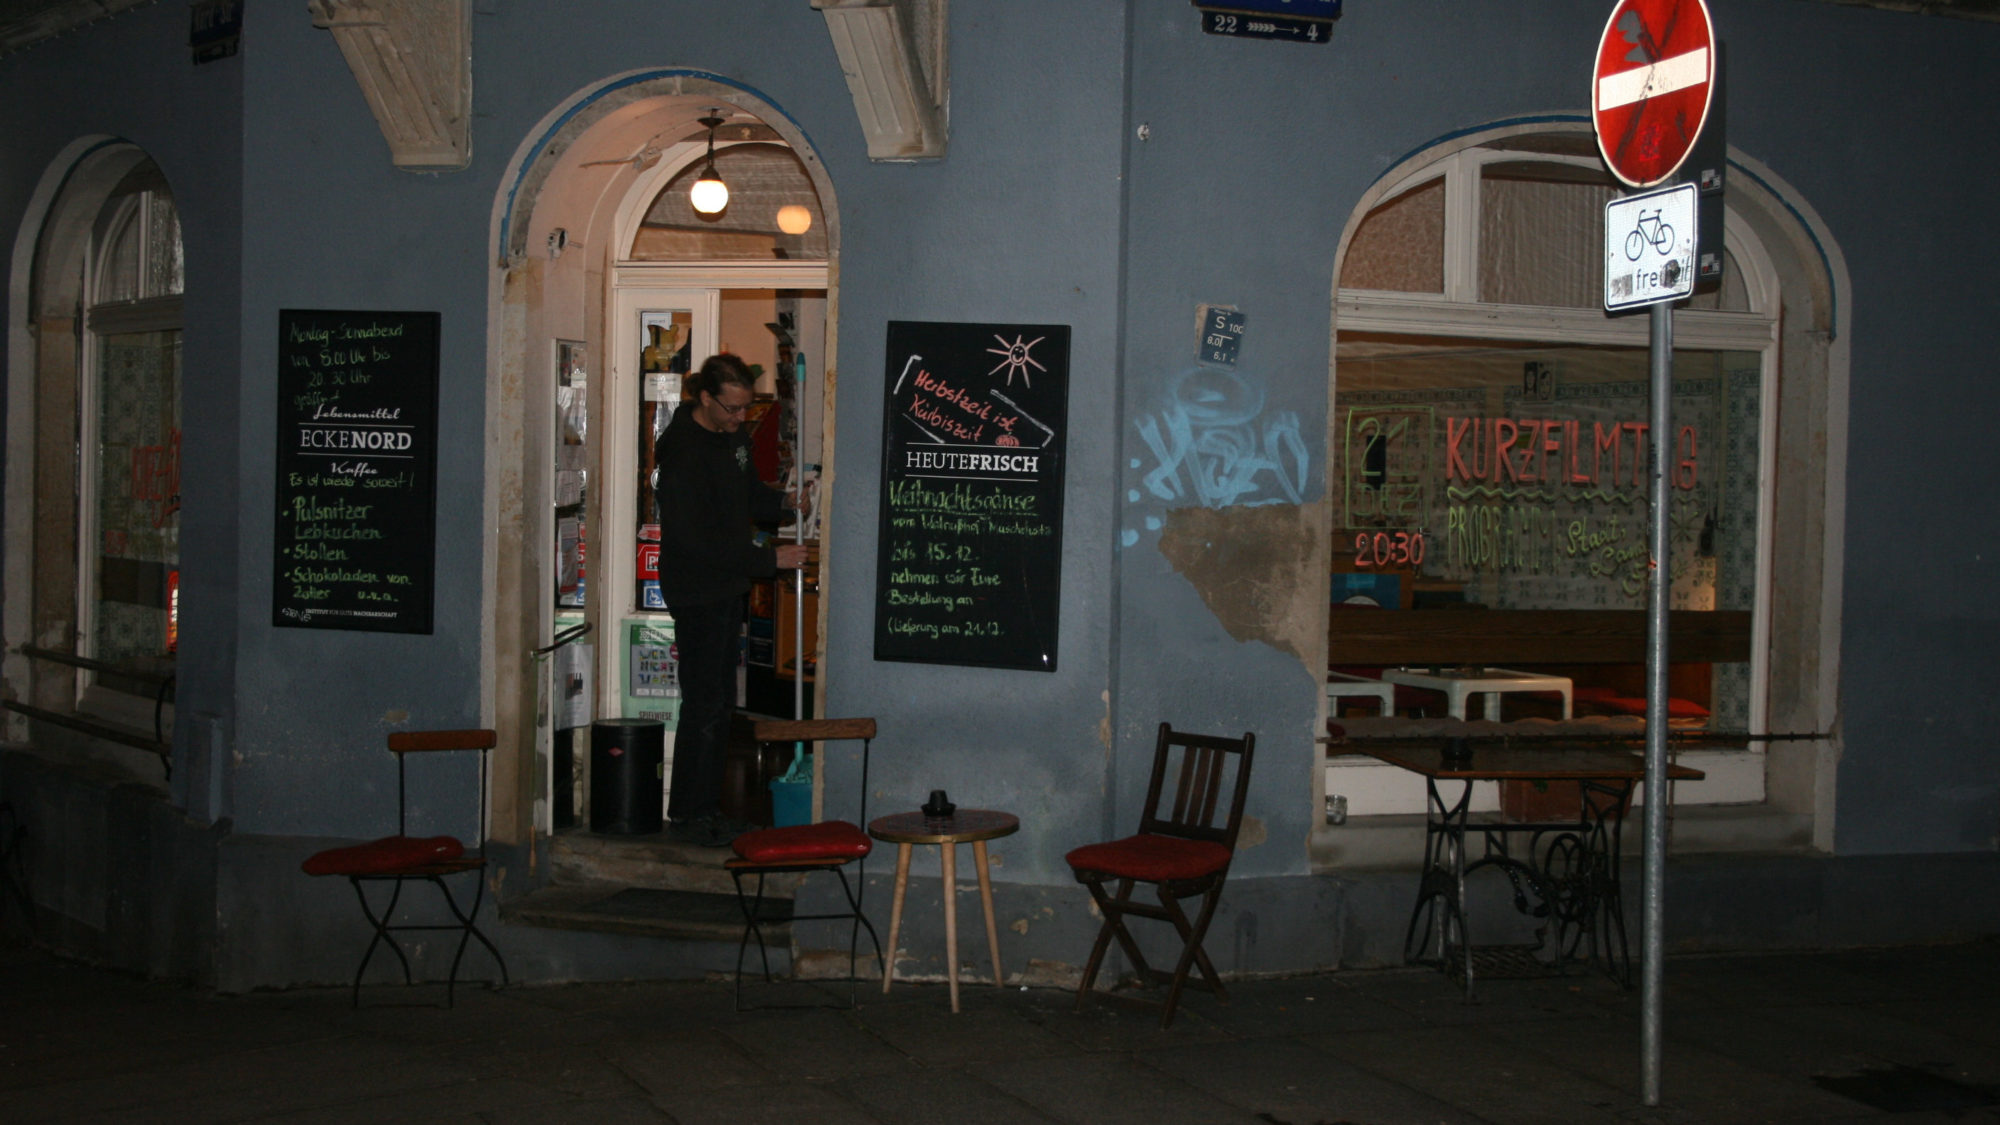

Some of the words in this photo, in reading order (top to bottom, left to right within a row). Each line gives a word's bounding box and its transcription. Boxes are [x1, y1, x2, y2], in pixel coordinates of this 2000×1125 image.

[1214, 14, 1238, 34] 22
[1306, 23, 1319, 41] 4
[1637, 268, 1661, 290] fre
[1215, 315, 1226, 330] S
[372, 345, 391, 362] bis
[913, 368, 993, 421] Herbstzeit
[992, 411, 1019, 432] ist
[312, 403, 401, 420] Lebensmittel
[908, 393, 985, 443] Kürbiszeit
[299, 428, 412, 450] ECKENORD
[905, 451, 1040, 473] HEUTEFRISCH
[1445, 414, 1699, 490] KURZFILMTG
[288, 472, 304, 487] Es
[329, 460, 379, 478] Kaffee
[291, 495, 375, 523] Pulsnitzer
[294, 522, 384, 541] Lebkuchen
[292, 542, 350, 562] Stollen
[1354, 531, 1426, 567] 20:30
[290, 565, 381, 585] Schokoladen
[890, 567, 940, 586] nehmen
[944, 568, 966, 585] wir
[969, 566, 1002, 587] Eure
[887, 588, 956, 613] Bestellung
[941, 624, 960, 635] am
